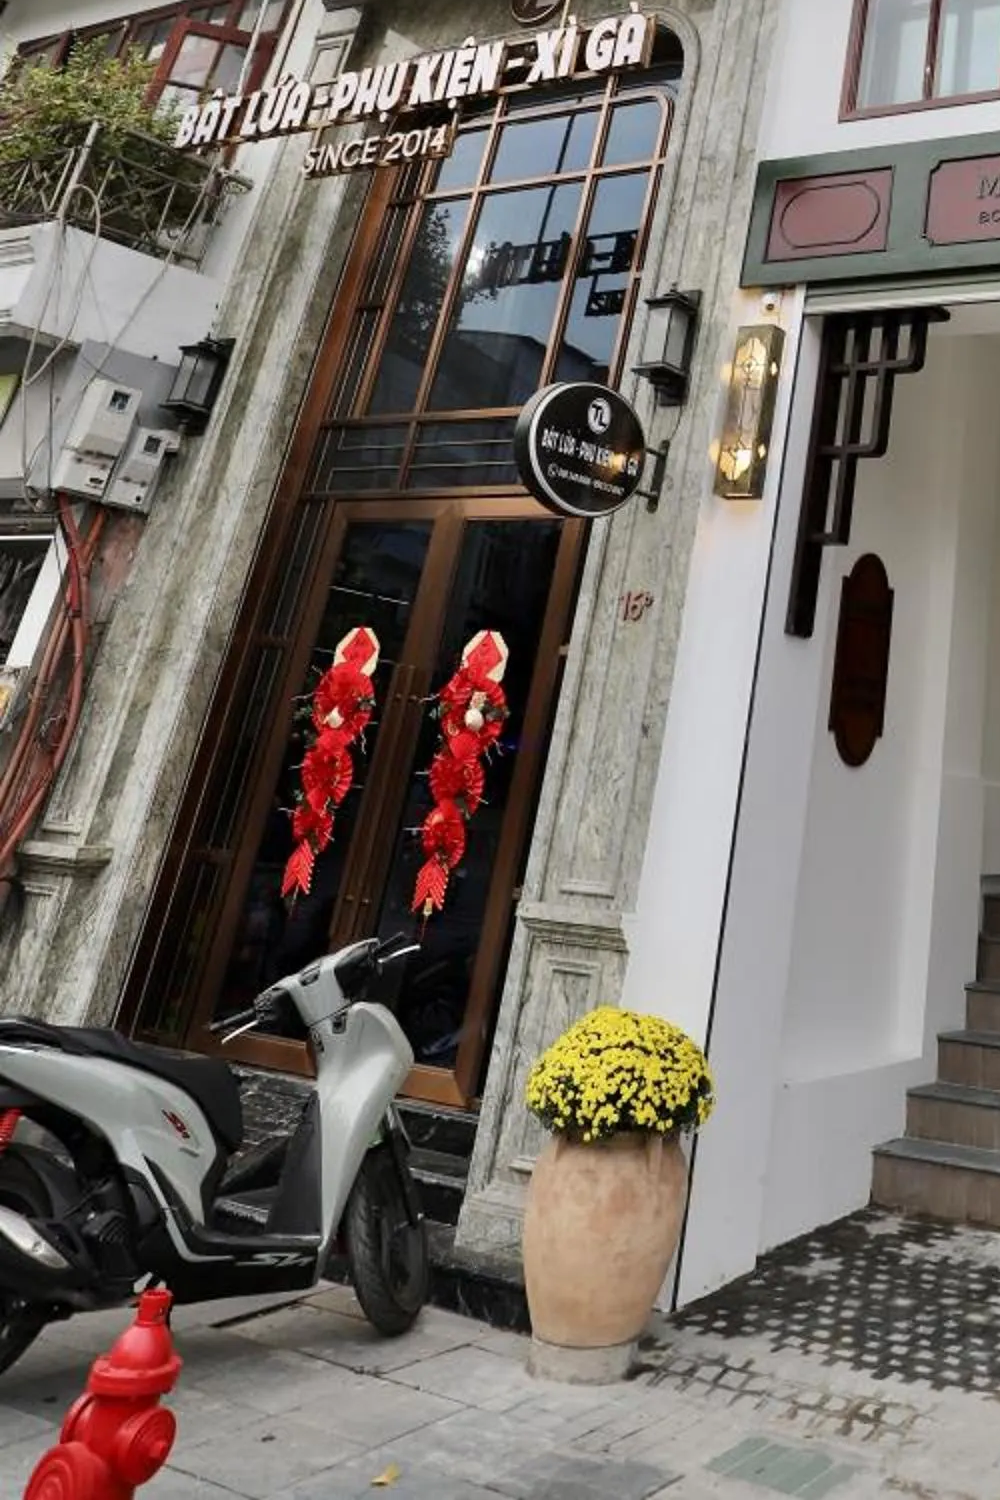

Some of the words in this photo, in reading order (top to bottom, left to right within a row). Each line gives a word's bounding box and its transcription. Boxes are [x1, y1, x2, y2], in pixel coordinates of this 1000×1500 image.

[174, 87, 242, 155] BẬT
[329, 61, 409, 122] PHỤ
[409, 36, 505, 108] KIỆN
[303, 135, 380, 173] SINCE
[384, 123, 447, 160] 2014
